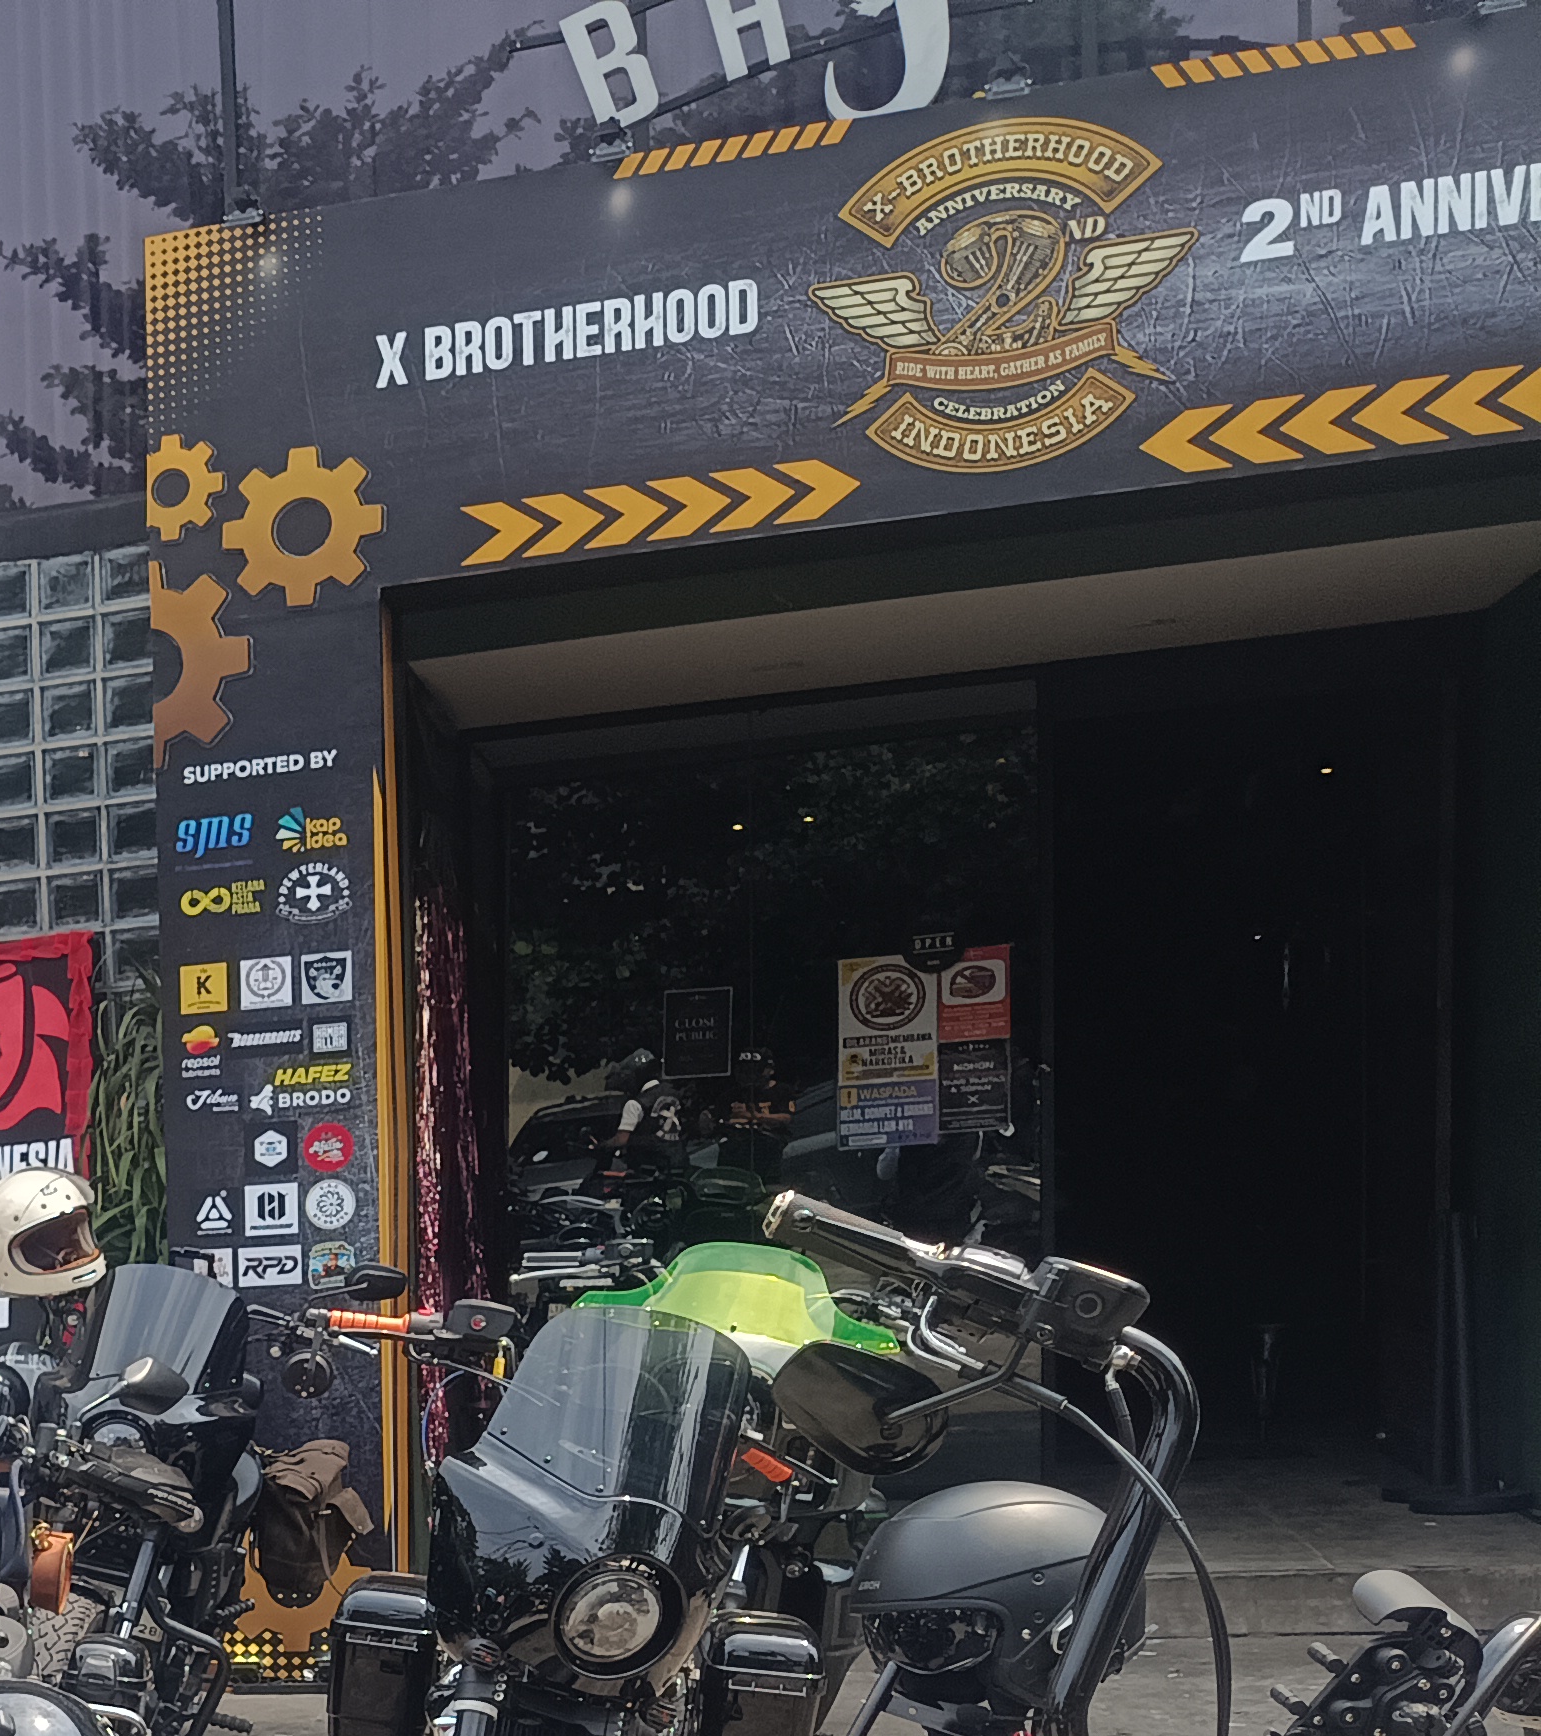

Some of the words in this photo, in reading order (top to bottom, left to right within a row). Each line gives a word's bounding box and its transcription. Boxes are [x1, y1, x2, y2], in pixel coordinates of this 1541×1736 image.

[863, 133, 1134, 222] X-BROTHERHOOD
[915, 183, 1082, 237] ANNIVERSARY
[375, 331, 409, 389] X
[423, 278, 759, 381] BROTHERHOOD
[895, 361, 923, 377] RIDE
[926, 365, 955, 380] WITH
[958, 363, 998, 380] HEART,
[1000, 356, 1046, 377] GATHER
[1047, 349, 1064, 367] AS
[1064, 332, 1108, 361] FAMILY
[933, 380, 1066, 421] CELEBRATION
[890, 393, 1115, 461] INDONESIA
[183, 753, 305, 785] SUPPORTED
[309, 749, 338, 769] BY
[181, 1054, 221, 1069] repsol
[274, 1062, 353, 1087] HAFEZ
[277, 1088, 352, 1108] BRODO
[858, 1085, 918, 1100] WASPADA
[241, 1254, 300, 1280] RPD
